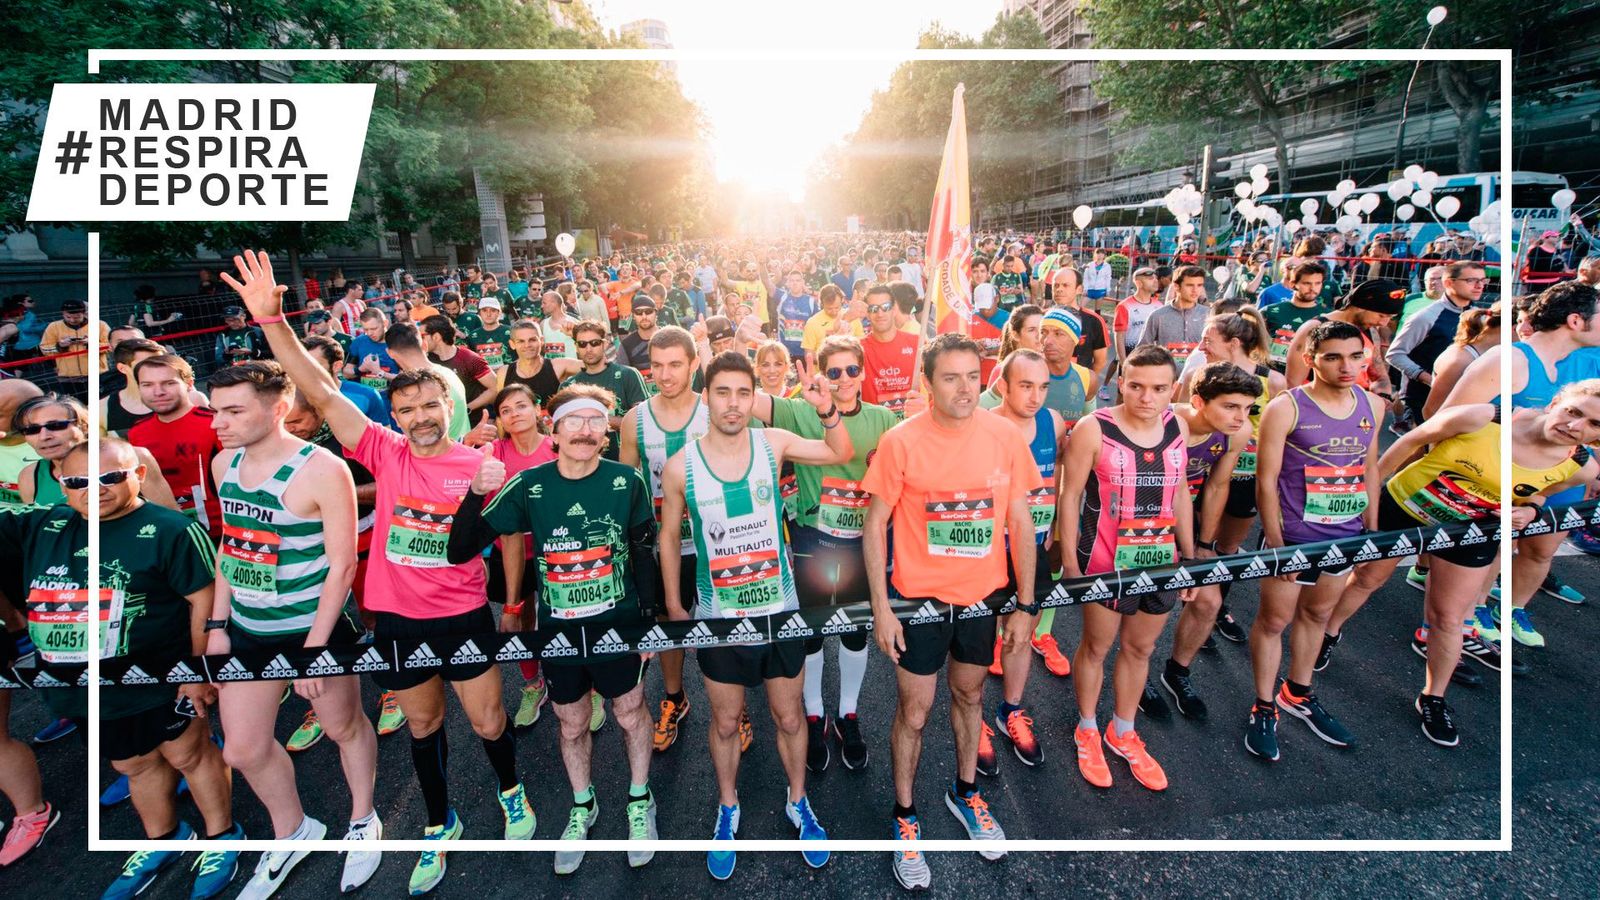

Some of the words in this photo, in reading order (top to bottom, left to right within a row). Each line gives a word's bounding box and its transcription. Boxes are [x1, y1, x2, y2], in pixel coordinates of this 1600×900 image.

[1512, 208, 1559, 219] OLCAR
[880, 366, 900, 376] edp
[1143, 476, 1180, 486] RUNNER
[223, 500, 273, 523] TIPTON
[1328, 499, 1358, 512] 40014
[729, 520, 768, 533] RENAULT
[837, 513, 864, 528] 40013
[1559, 520, 1586, 530] adidas
[552, 525, 569, 537] edp
[950, 528, 984, 543] 40018
[1524, 525, 1550, 535] adidas
[408, 537, 445, 555] 40069
[1426, 541, 1455, 551] adidas
[1460, 535, 1487, 545] adidas
[543, 541, 582, 552] MADRID
[715, 538, 772, 556] MULTIAUTO
[1387, 546, 1416, 557] adidas
[1134, 551, 1163, 564] 40049
[1317, 555, 1347, 567] adidas
[1353, 550, 1382, 561] adidas
[46, 564, 68, 577] edp
[1281, 561, 1312, 572] adidas
[233, 566, 262, 587] 40036
[1202, 573, 1233, 584] adidas
[1239, 567, 1270, 579] adidas
[30, 579, 79, 590] MADRID
[1126, 583, 1158, 595] adidas
[1164, 578, 1196, 590] adidas
[568, 584, 602, 604] 40084
[738, 586, 770, 605] 40035
[1081, 590, 1113, 602] adidas
[1040, 595, 1074, 607] adidas
[909, 613, 945, 625] adidas
[958, 607, 992, 620] adidas
[777, 626, 813, 639] adidas
[821, 622, 858, 635] adidas
[46, 631, 85, 648] 40451
[682, 633, 719, 646] adidas
[726, 629, 763, 642] adidas
[592, 640, 629, 653] adidas
[637, 637, 674, 649] adidas
[495, 649, 533, 661] adidas
[541, 645, 578, 657] adidas
[404, 656, 442, 668] adidas
[450, 653, 487, 665] adidas
[261, 666, 298, 679] adidas
[306, 663, 344, 676] adidas
[352, 661, 390, 673] adidas
[121, 675, 159, 684] adidas
[166, 673, 203, 682] adidas
[217, 669, 254, 680] adidas
